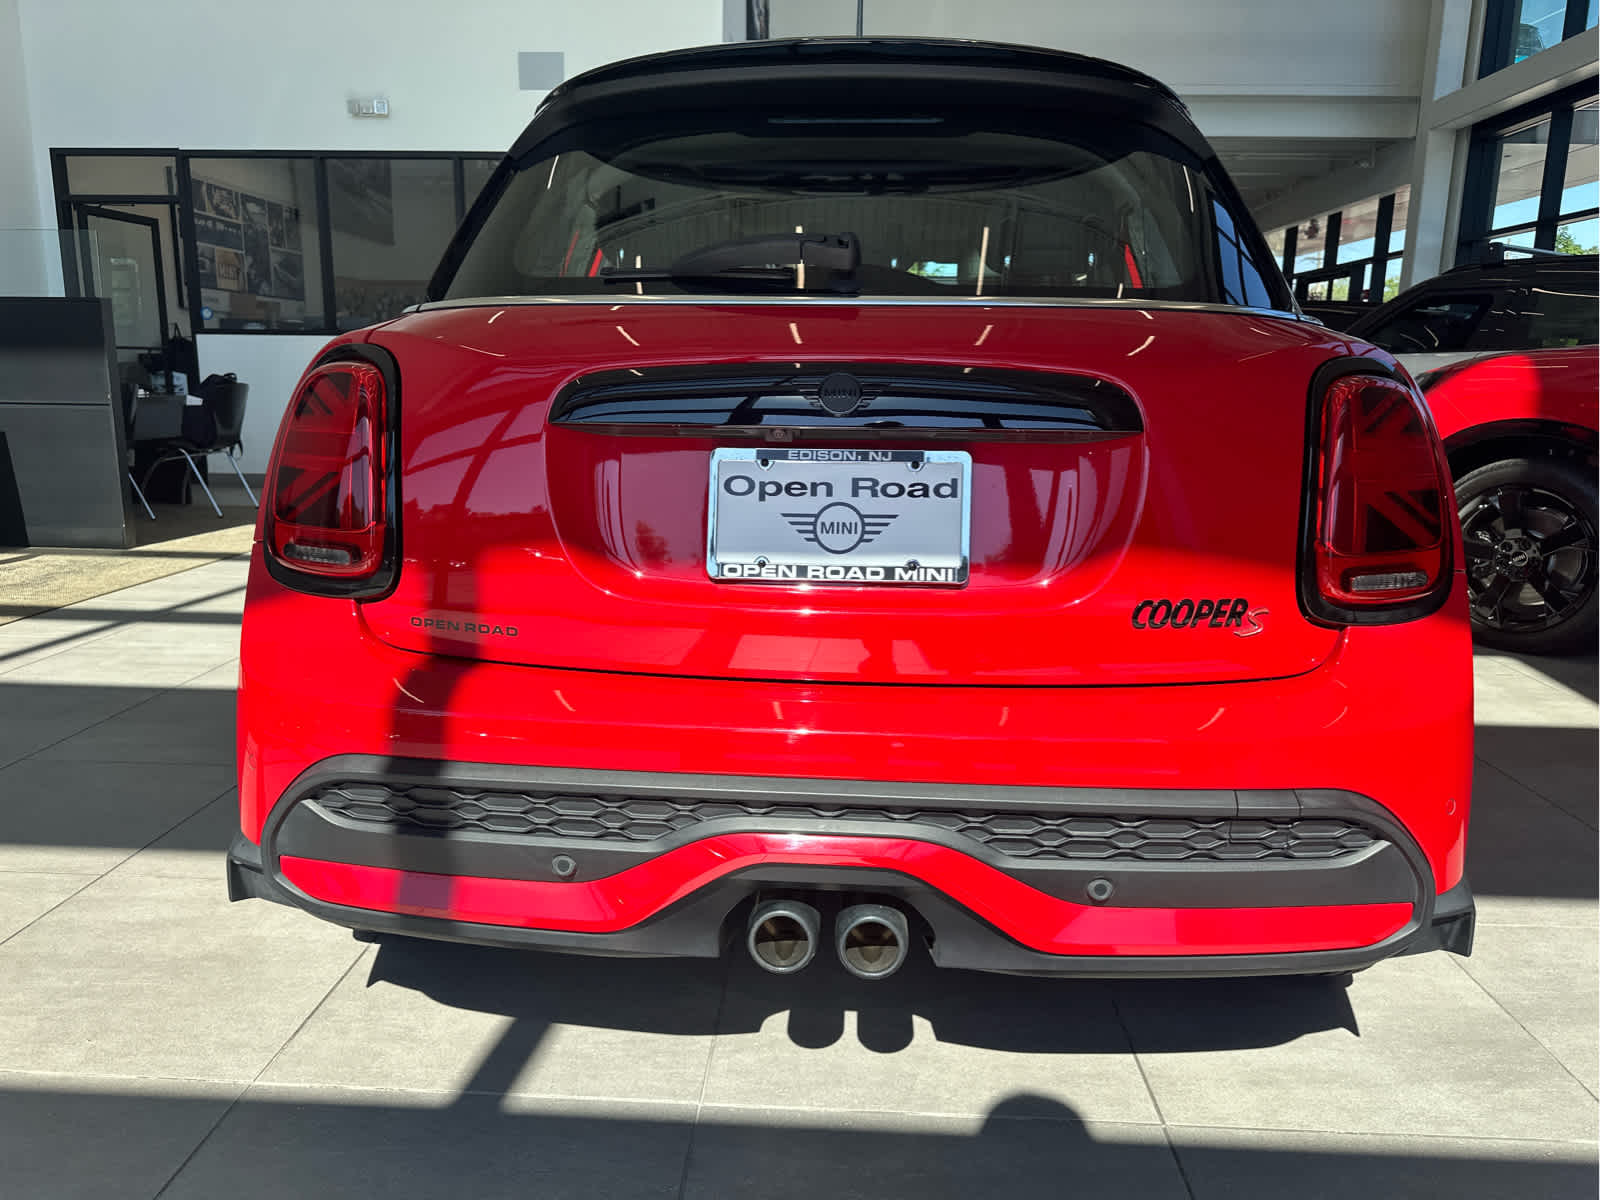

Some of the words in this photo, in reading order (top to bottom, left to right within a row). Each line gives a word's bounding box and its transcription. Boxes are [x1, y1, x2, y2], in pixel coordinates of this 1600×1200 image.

[787, 449, 863, 462] EDISON,
[868, 451, 893, 463] NJ
[723, 474, 834, 502] Open
[851, 477, 959, 499] Road
[820, 521, 859, 536] MINI
[723, 563, 798, 578] OPEN
[807, 564, 884, 581] ROAD
[894, 566, 953, 582] MINI
[1131, 598, 1249, 630] COOPER
[410, 616, 460, 632] OPEN
[463, 622, 519, 637] ROAD
